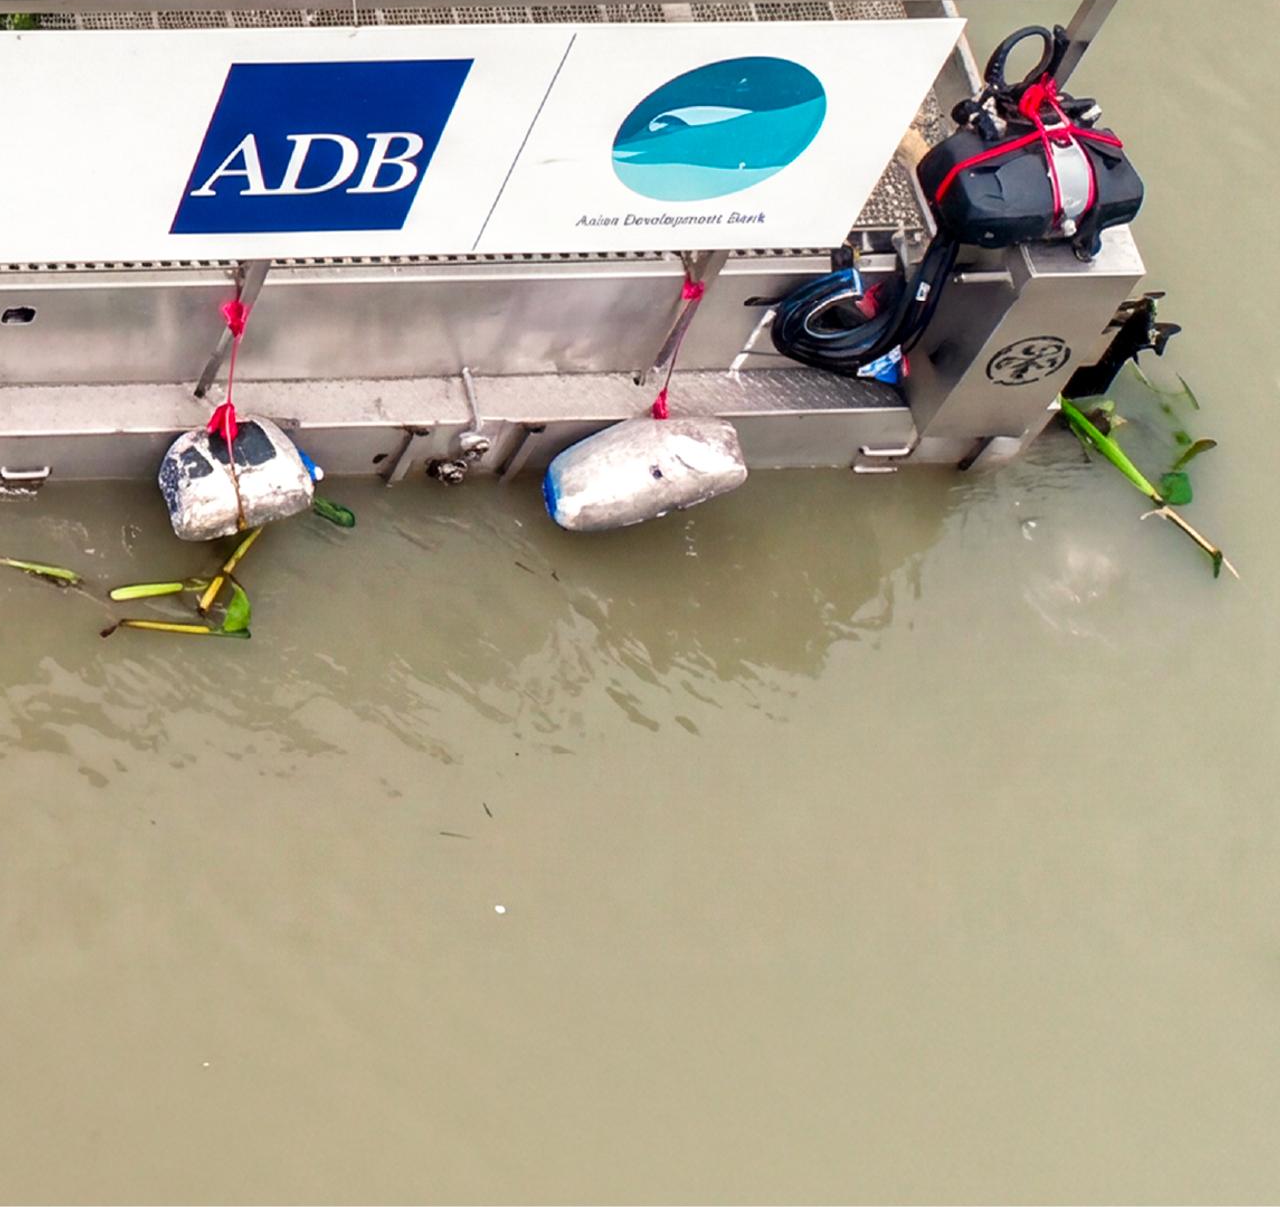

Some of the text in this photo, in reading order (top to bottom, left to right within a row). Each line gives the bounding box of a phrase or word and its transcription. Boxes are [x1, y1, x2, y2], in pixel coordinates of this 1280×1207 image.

[190, 131, 424, 196] ADB
[624, 213, 722, 228] Development
[727, 211, 765, 224] Bank
